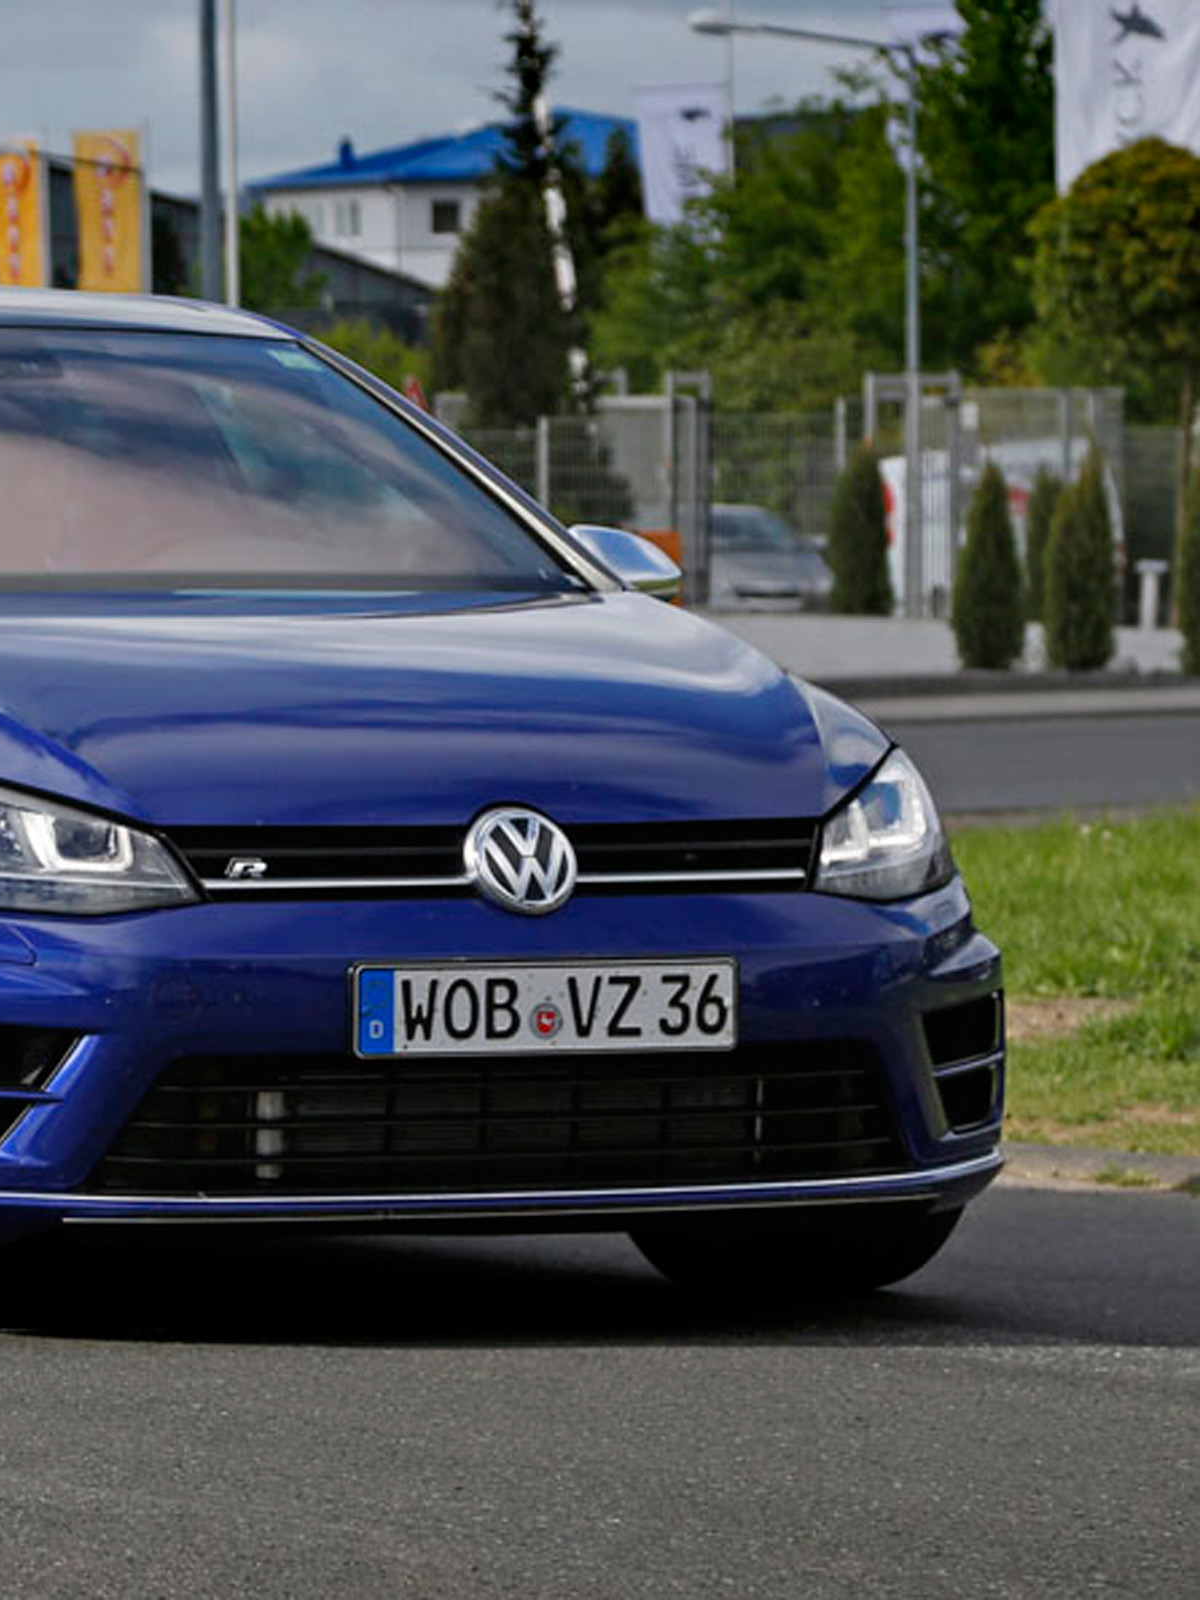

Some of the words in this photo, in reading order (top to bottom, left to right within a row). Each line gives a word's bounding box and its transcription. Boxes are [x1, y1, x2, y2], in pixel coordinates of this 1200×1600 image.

[224, 857, 268, 878] R
[401, 977, 521, 1041] WOB
[567, 975, 643, 1038] VZ
[659, 974, 729, 1037] 36
